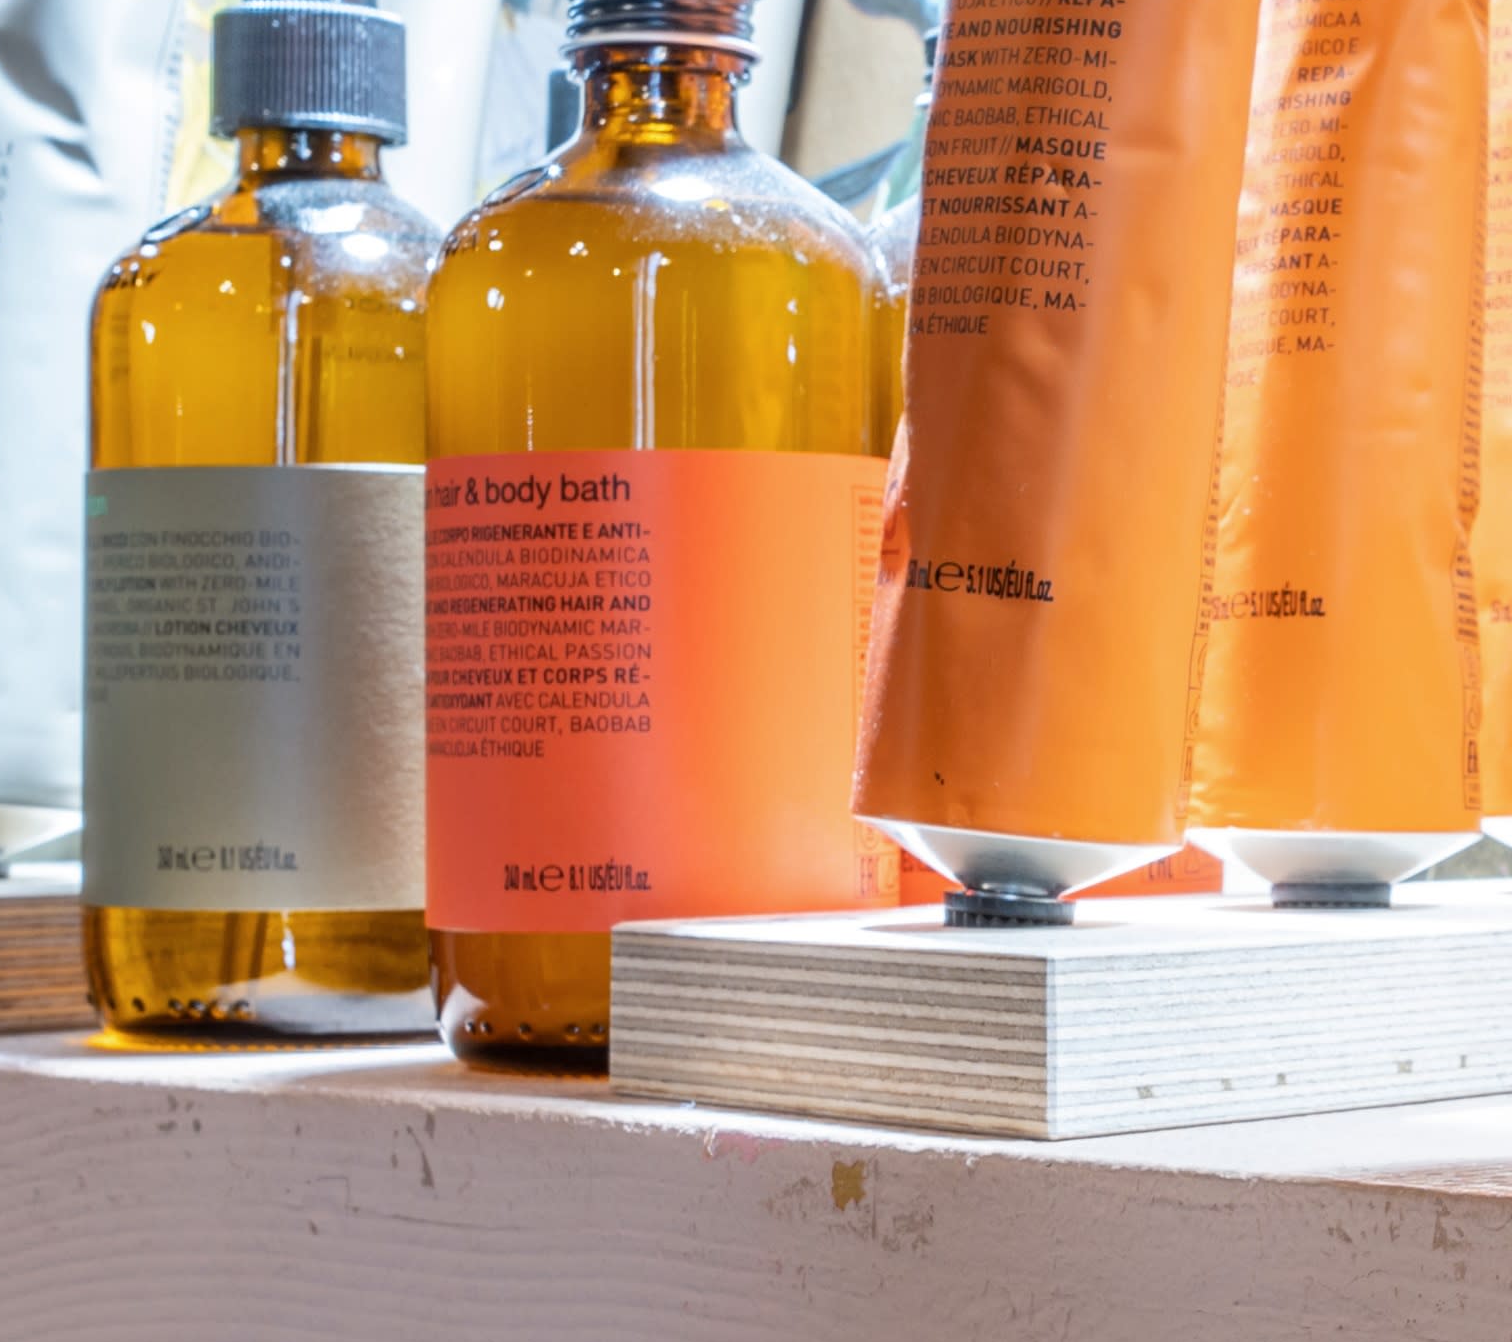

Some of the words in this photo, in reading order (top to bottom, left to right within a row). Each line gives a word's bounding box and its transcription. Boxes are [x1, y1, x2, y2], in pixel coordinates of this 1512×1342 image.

[996, 18, 1121, 38] NOURISHING
[1024, 47, 1116, 67] ZERO-MI-
[1007, 77, 1112, 101] MARIGOLD,
[1025, 107, 1111, 130] ETHICAL
[1016, 137, 1107, 159] MASQUE
[1005, 163, 1101, 187] RÉPARA-
[1010, 257, 1089, 283] COURT,
[486, 475, 551, 509] body
[561, 474, 630, 501] bath
[472, 524, 576, 541] RIGENERANTE
[598, 524, 651, 539] ANTI-
[497, 571, 588, 587] MARACUJA
[561, 596, 603, 611] HAIR
[610, 596, 650, 611] AND
[565, 643, 651, 659] PASSION
[544, 668, 607, 683] CORPS
[501, 716, 563, 736] COURT,
[571, 716, 651, 732] BAOBAB
